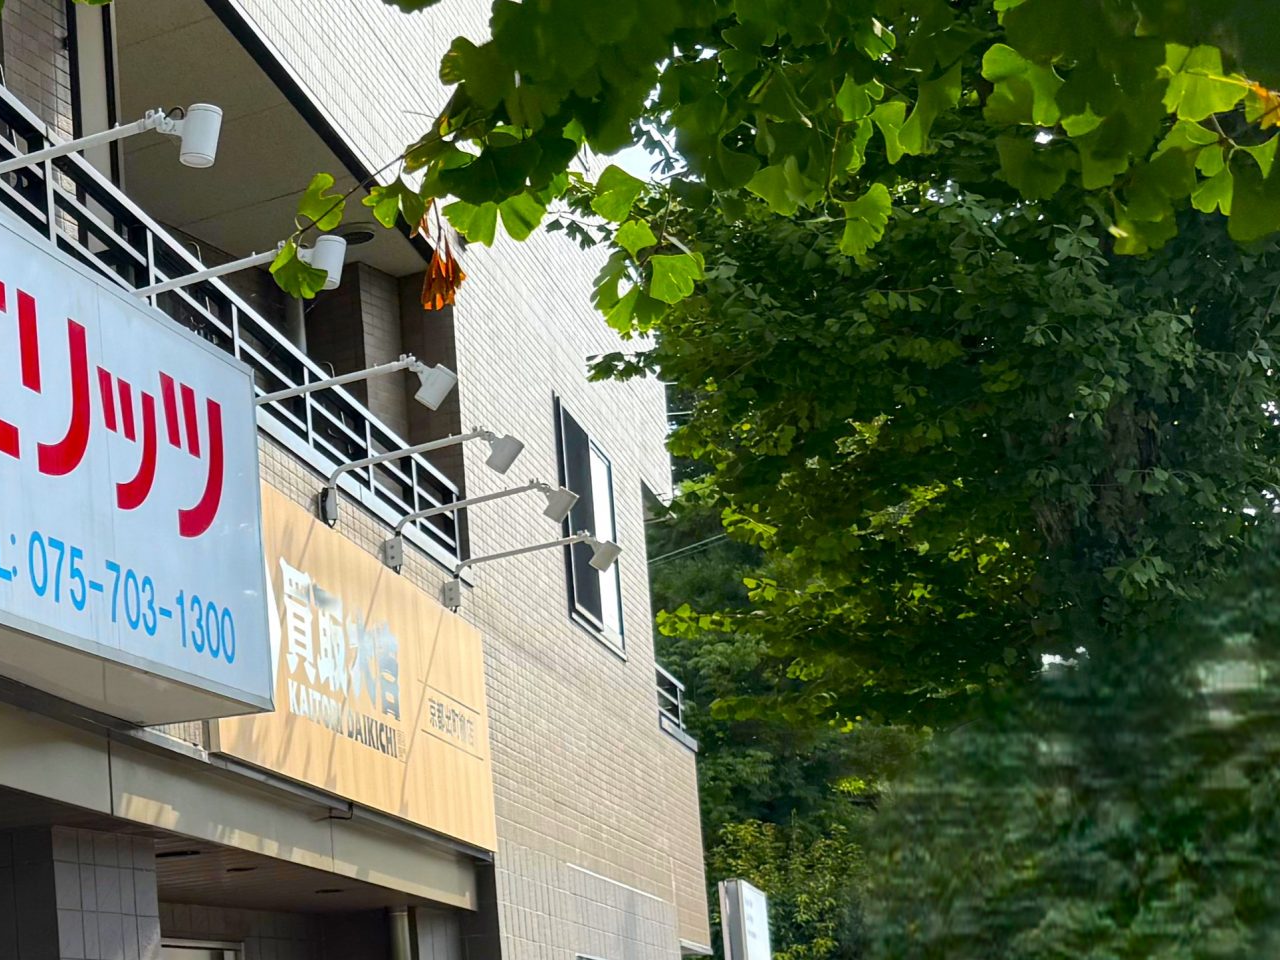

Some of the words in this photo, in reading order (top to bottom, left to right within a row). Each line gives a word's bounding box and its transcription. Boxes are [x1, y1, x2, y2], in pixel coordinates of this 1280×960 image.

[27, 530, 236, 664] 075-703-1300
[280, 556, 400, 721] 買取大吉
[346, 712, 398, 759] DAIKICHI
